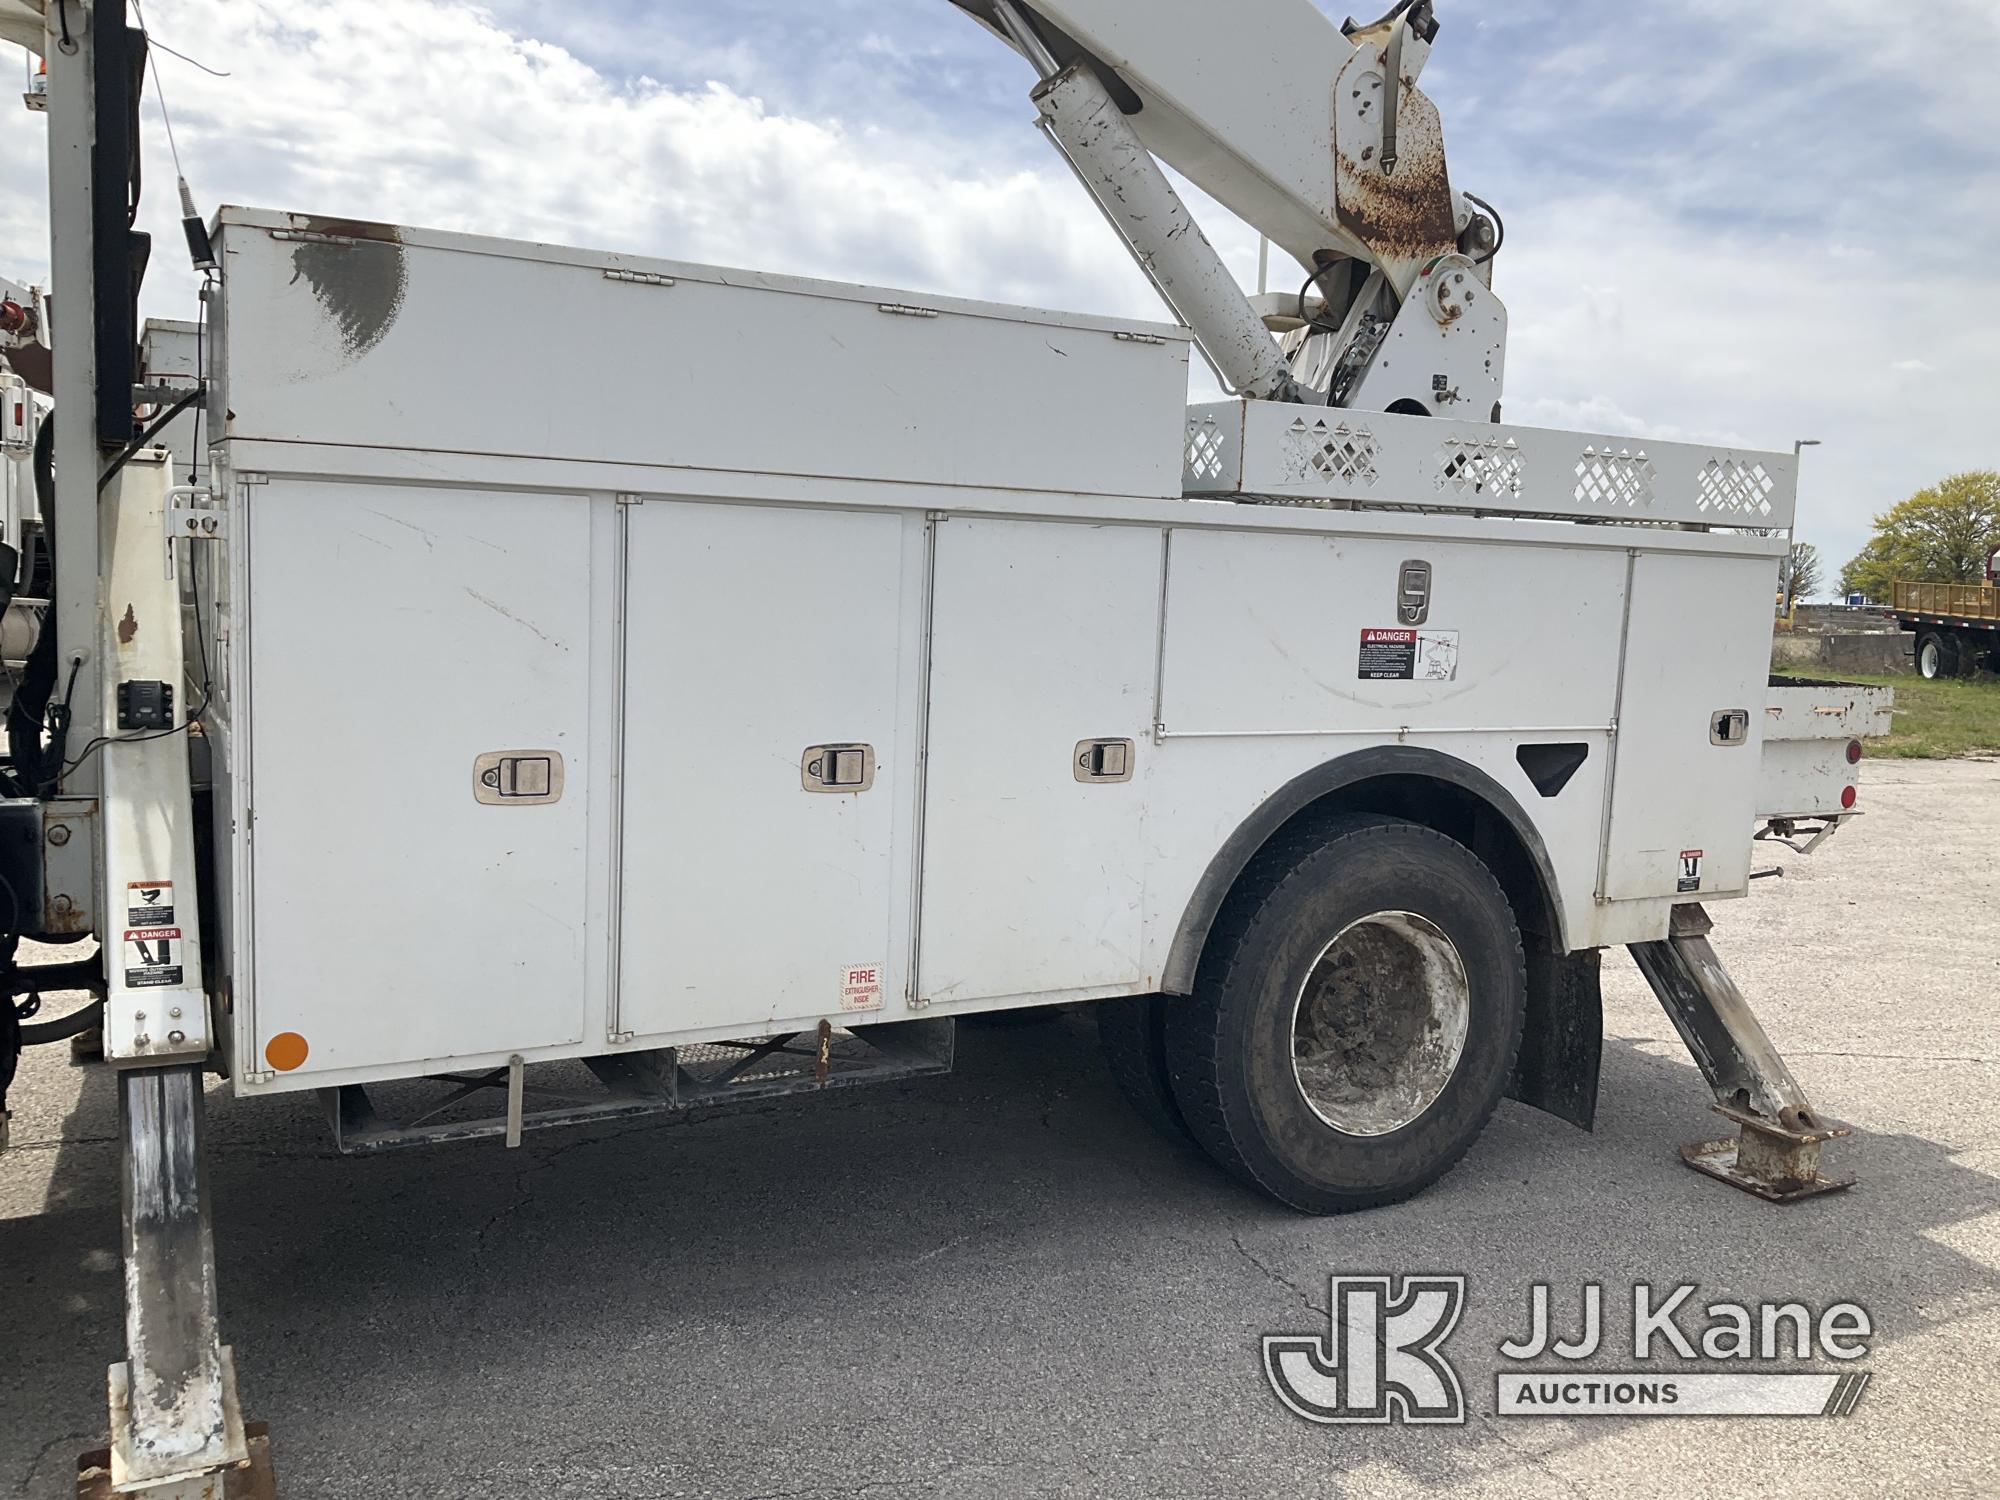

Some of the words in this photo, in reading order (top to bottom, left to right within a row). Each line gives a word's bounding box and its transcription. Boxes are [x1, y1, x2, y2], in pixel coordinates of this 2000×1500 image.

[1376, 631, 1410, 641] DANGER
[141, 930, 176, 938] DANGER
[849, 969, 875, 984] FIRE
[845, 985, 879, 995] EXTINGUISHER
[854, 995, 869, 1003] INSIDE
